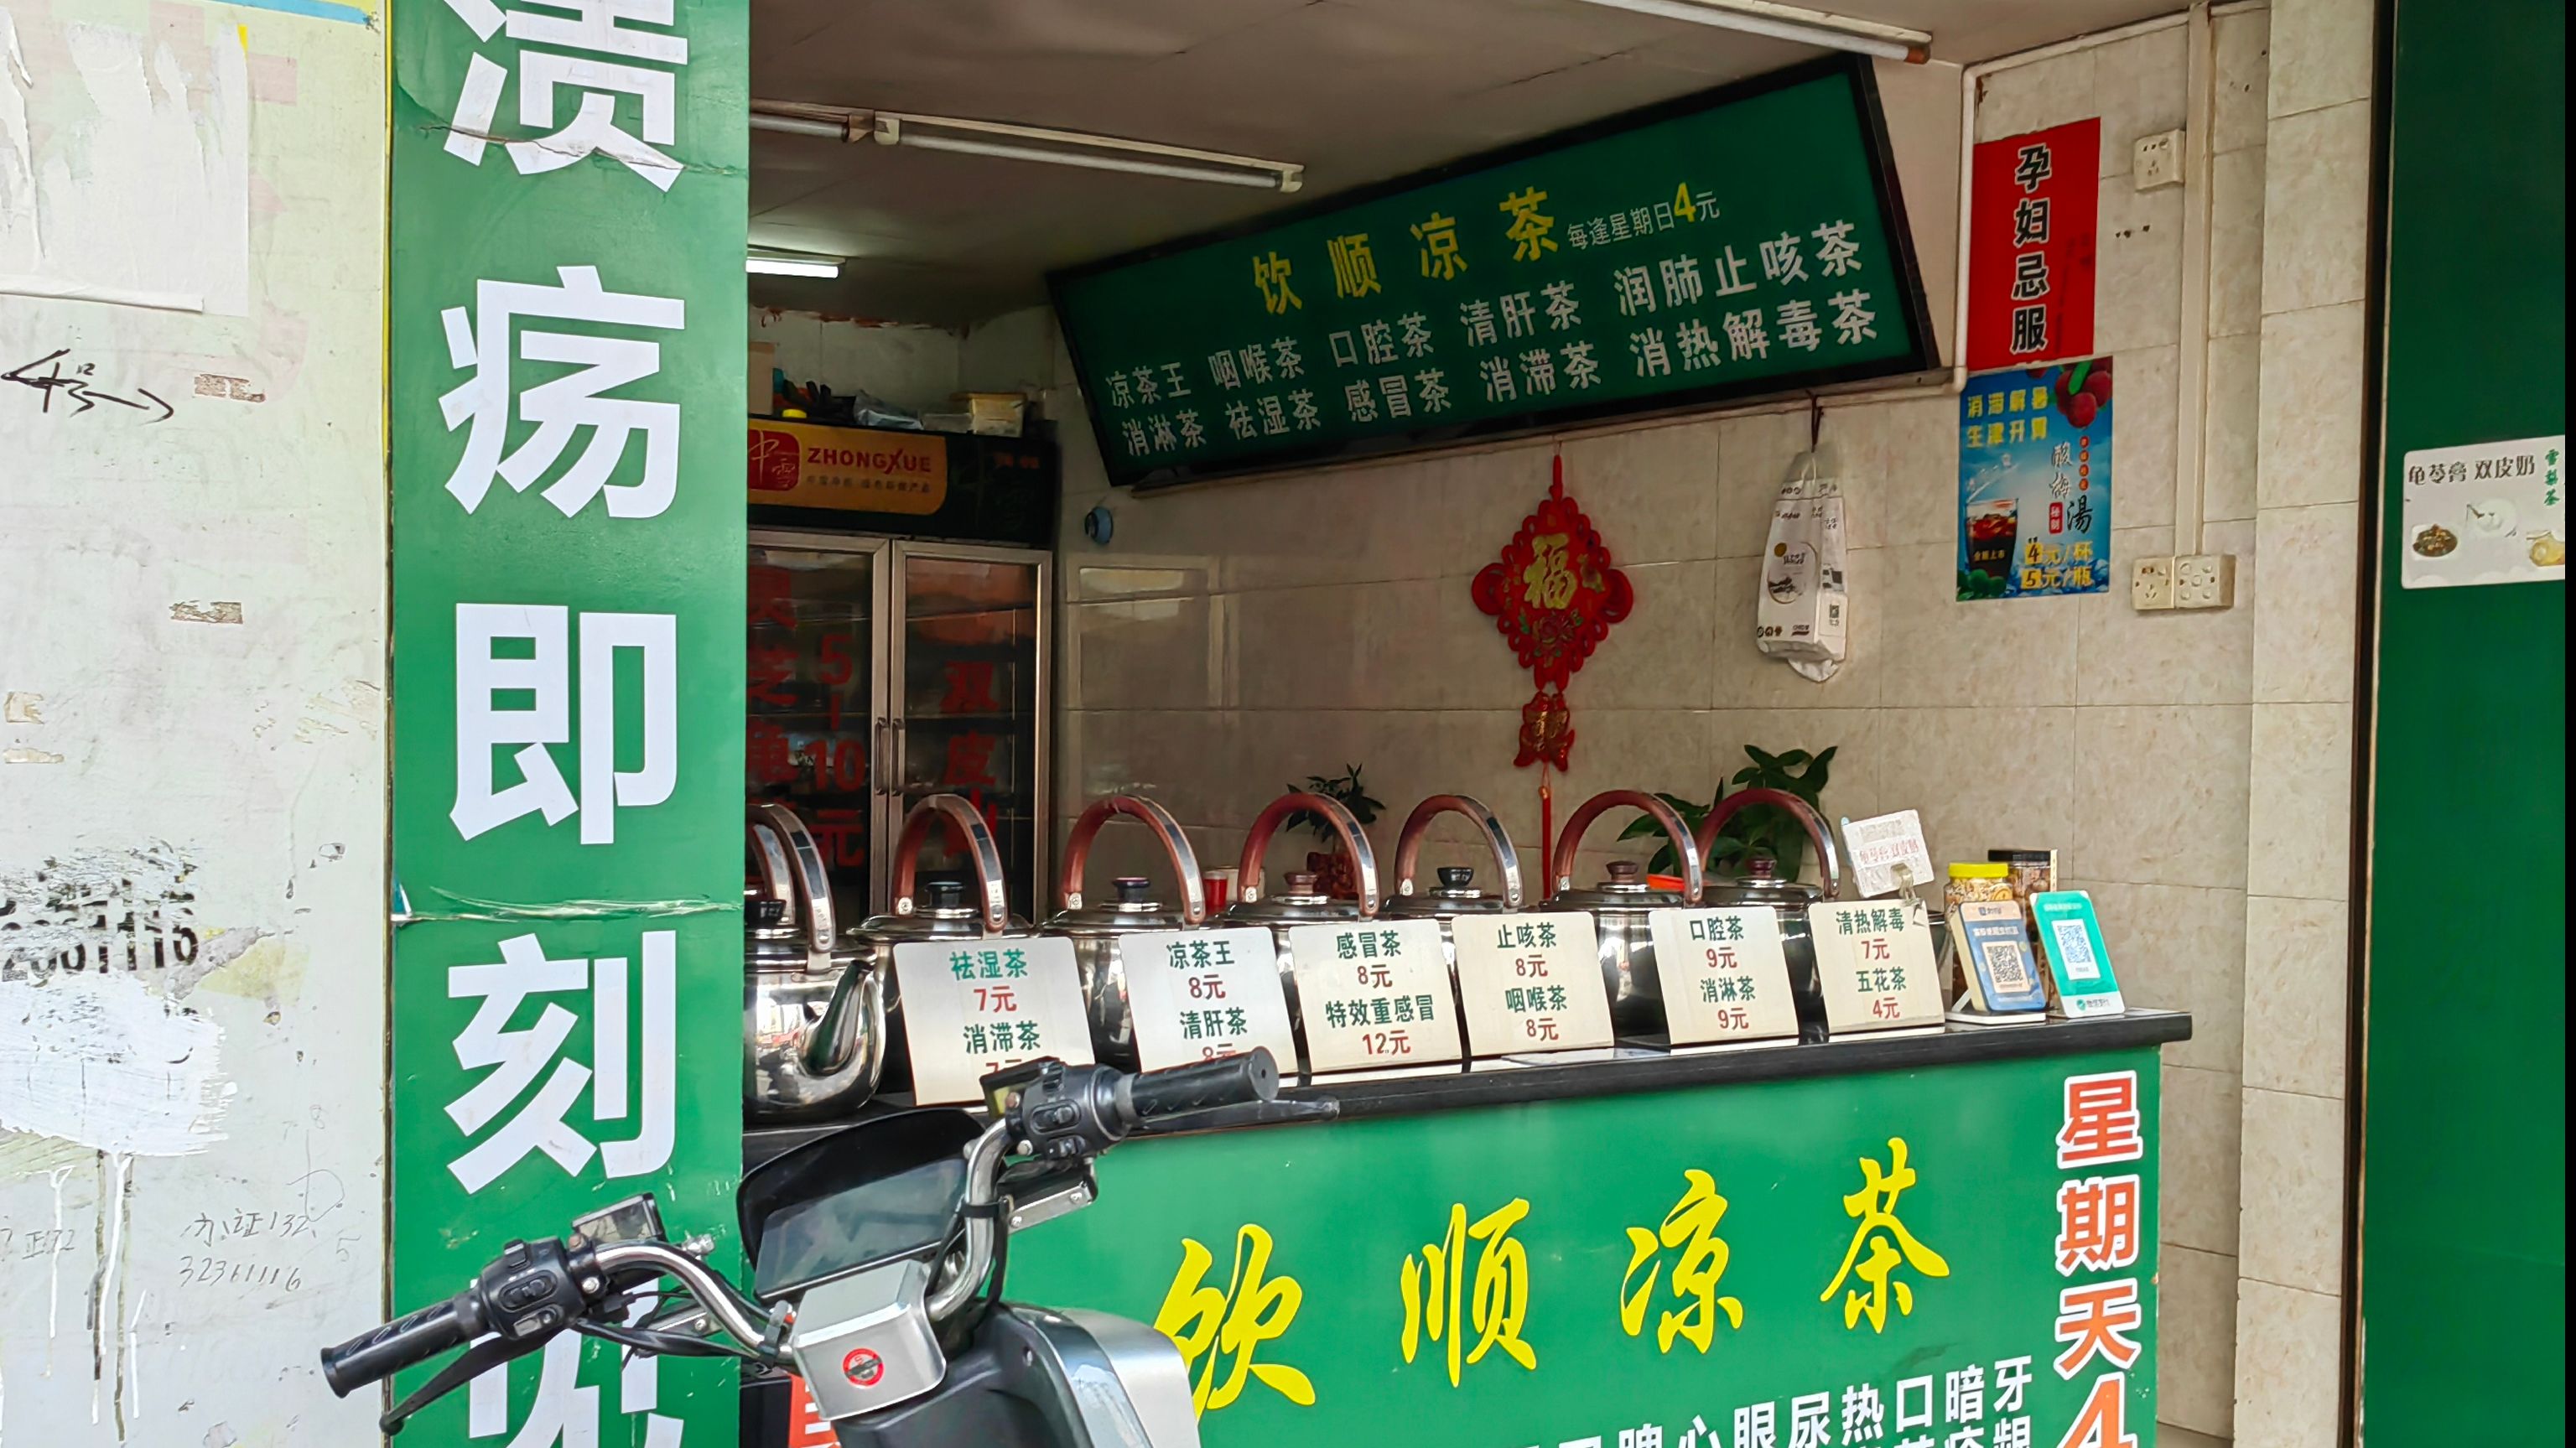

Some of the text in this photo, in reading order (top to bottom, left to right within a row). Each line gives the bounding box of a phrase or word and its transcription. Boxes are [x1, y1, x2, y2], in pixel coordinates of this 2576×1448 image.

[1251, 181, 1720, 317] 饮顺凉茶 每逢星期日4元
[2010, 141, 2052, 356] 孕妇忌服
[1105, 220, 1863, 410] 凉茶王 咽喉茶 口腔茶 清肝茶 润肺止咳茶
[1122, 288, 1878, 458] 消淋茶 祛湿茶 感冒茶 消滞茶 消热解毒茶
[807, 447, 932, 475] ZHONGXUE
[2408, 454, 2535, 485] 龟苓膏 双皮奶
[1523, 532, 1578, 610] 福
[1689, 916, 1745, 942] 口腔茶
[1836, 908, 1906, 936] 清热解毒
[1337, 930, 1402, 960] 感冒茶
[1497, 922, 1558, 951] 止咳茶
[1861, 938, 1891, 961] 7元
[950, 948, 1029, 981] 祛湿茶
[1166, 940, 1236, 969] 凉茶王
[1516, 954, 1549, 978] 8元
[1706, 947, 1738, 970] 9元
[1188, 973, 1227, 1000] 8元
[1357, 964, 1394, 989] 8元
[1700, 976, 1756, 1004] 消淋茶
[1856, 968, 1907, 994] 五花茶
[974, 985, 1018, 1013] 7元
[1326, 994, 1435, 1029] 特效重感冒
[1505, 985, 1568, 1013] 咽喉茶
[1872, 997, 1901, 1020] 4元
[1180, 1006, 1249, 1040] 清肝茶
[1525, 1017, 1560, 1042] 8元
[1717, 1007, 1749, 1031] 9元
[963, 1021, 1041, 1054] 消滞茶
[1362, 1029, 1411, 1056] 12元
[1152, 1136, 1950, 1423] 饮顺凉茶
